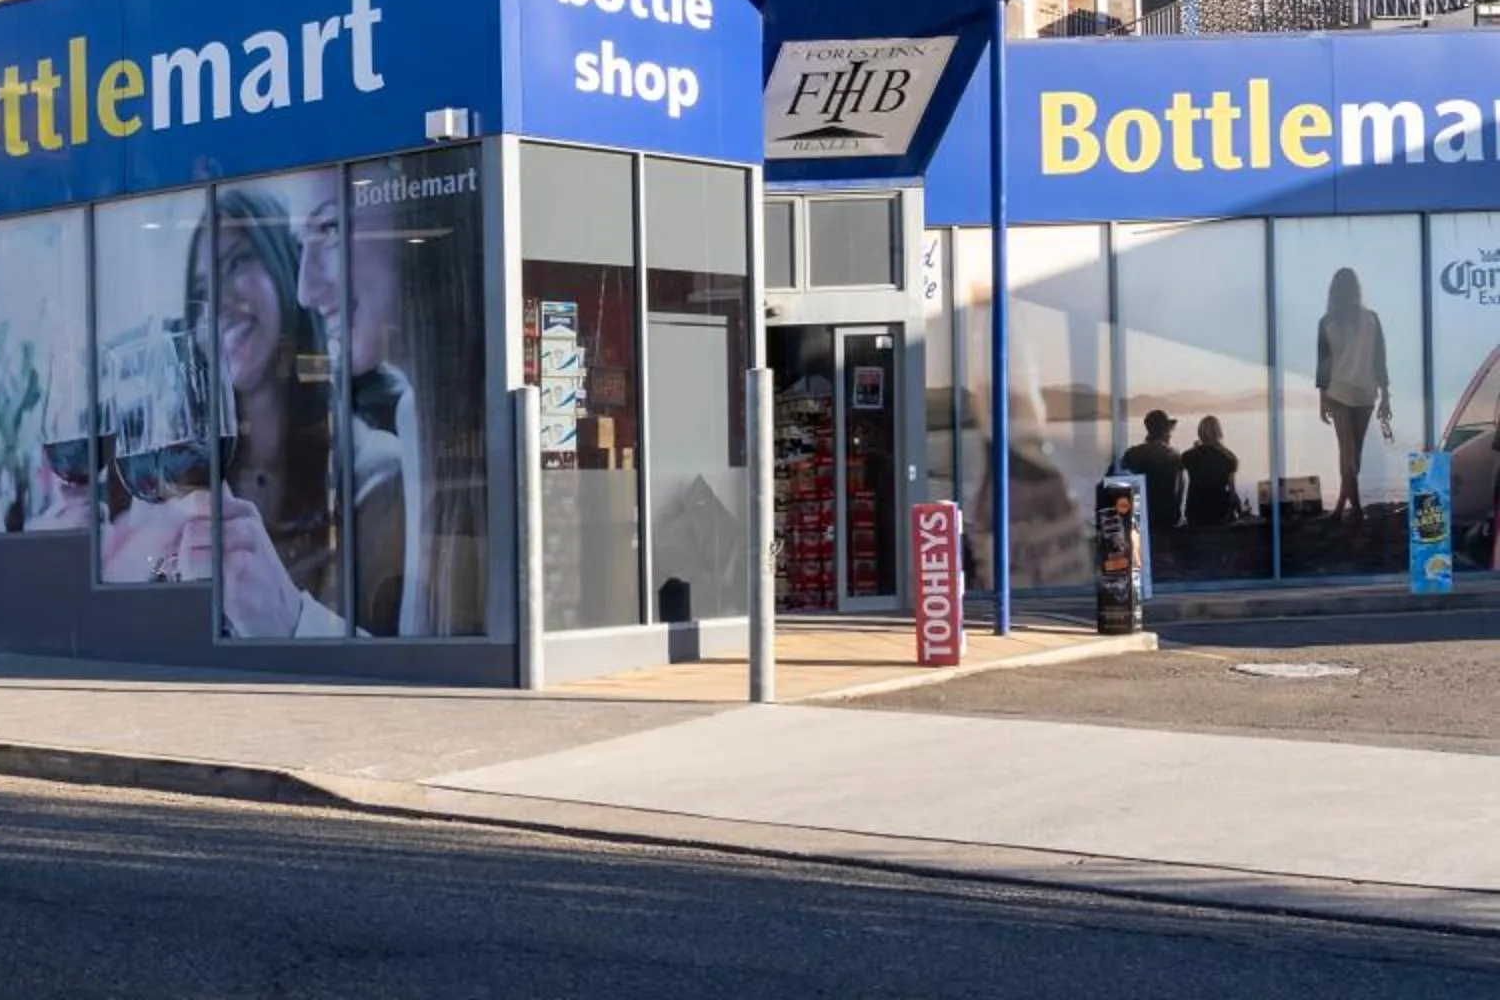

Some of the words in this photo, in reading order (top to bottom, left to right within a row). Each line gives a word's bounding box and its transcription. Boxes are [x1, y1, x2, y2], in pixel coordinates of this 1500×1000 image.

[575, 39, 700, 119] shop
[1040, 78, 1500, 175] Bottlema
[355, 167, 477, 208] Bottlemart
[919, 513, 952, 661] TOOHEYS
